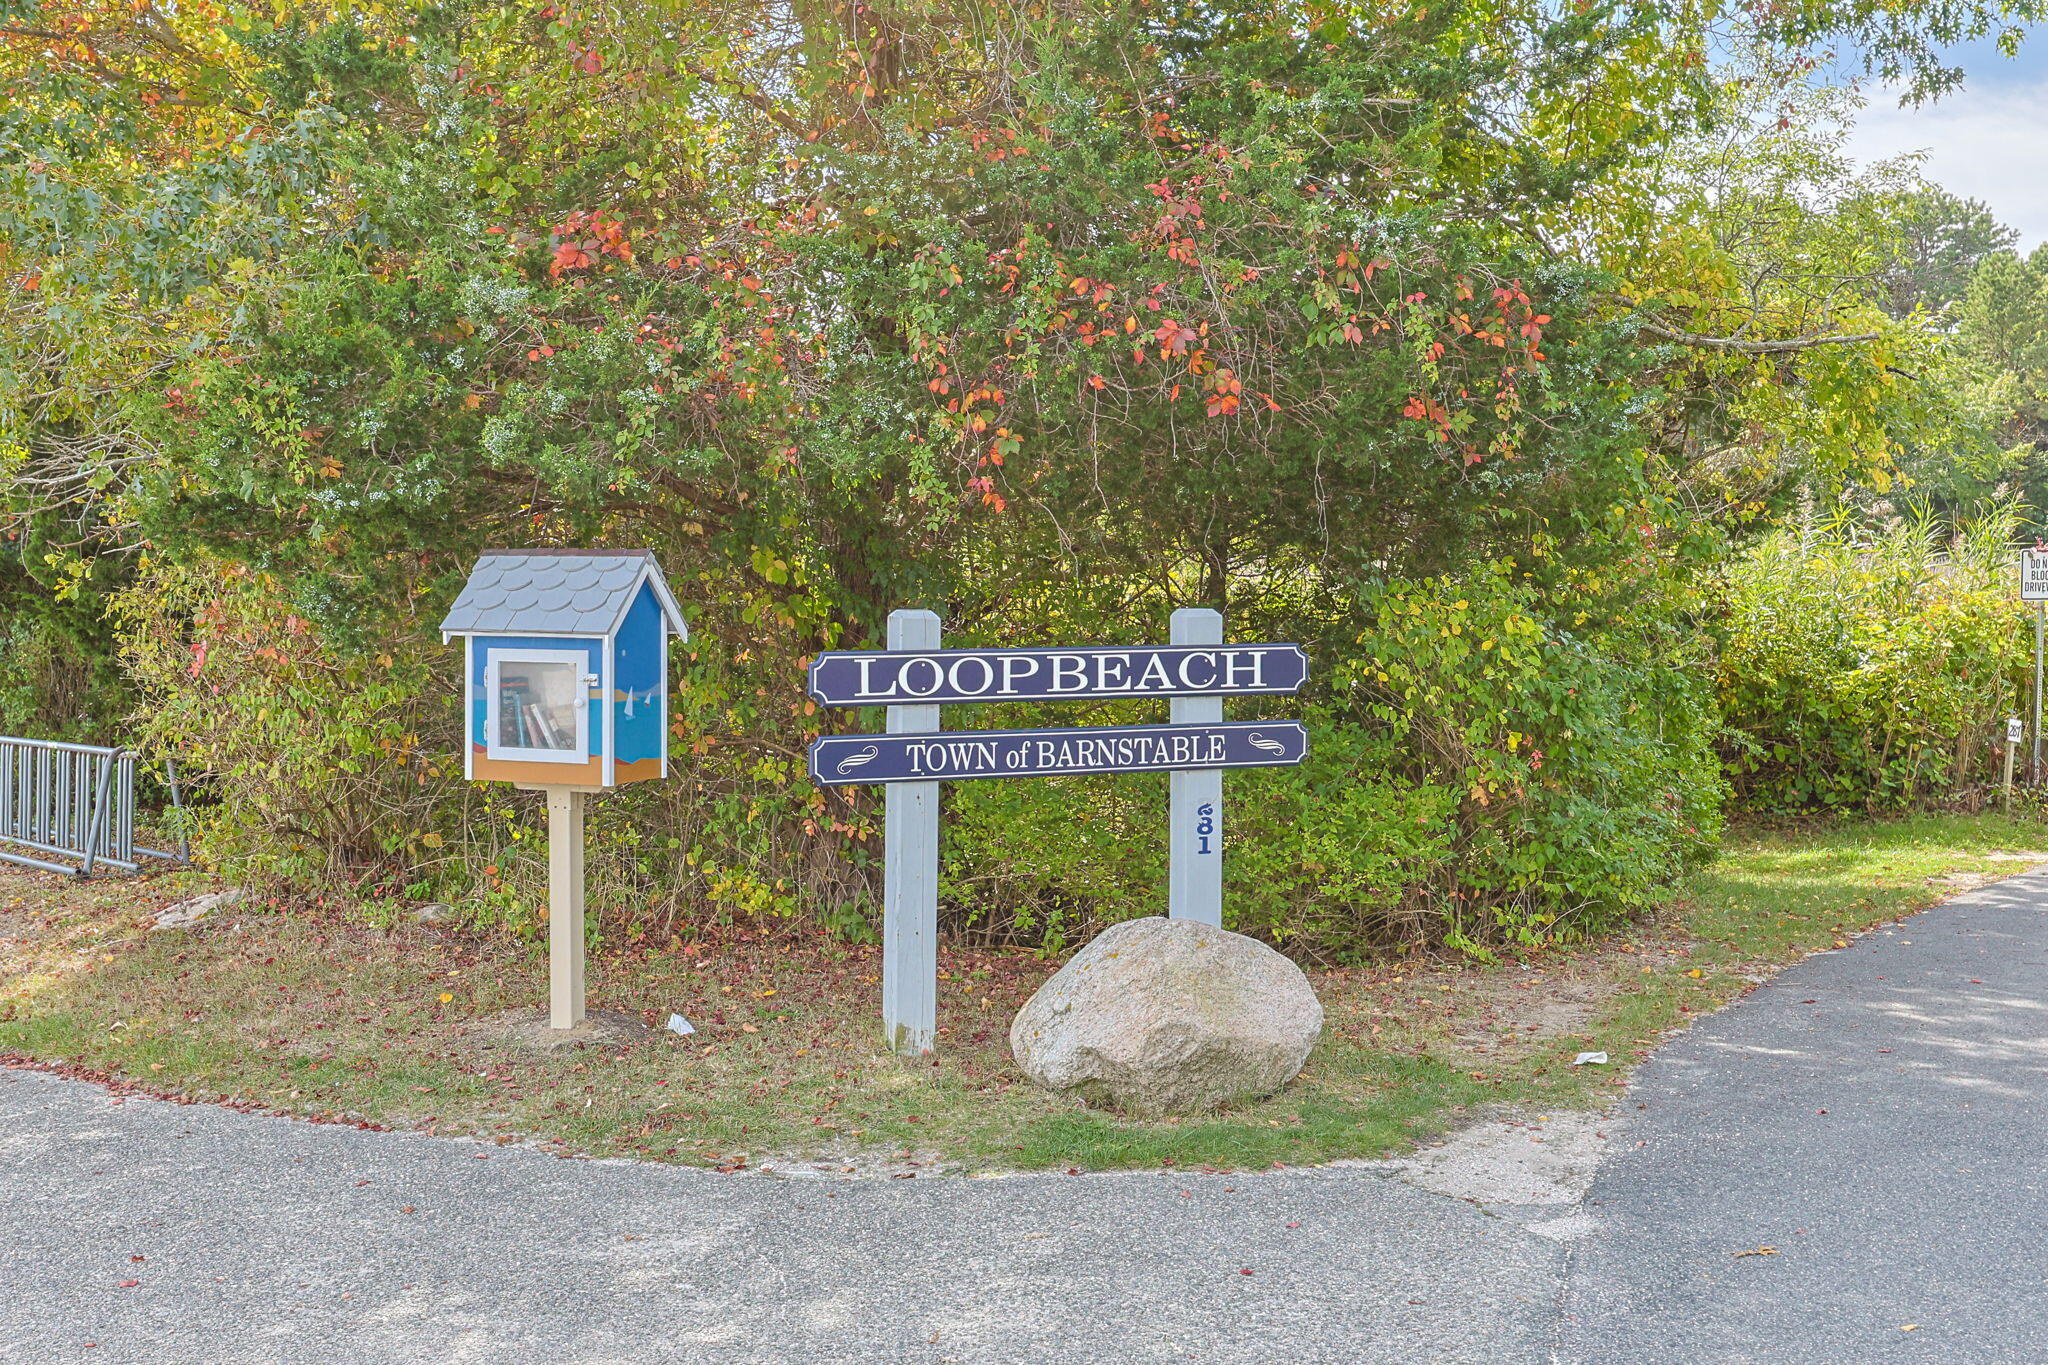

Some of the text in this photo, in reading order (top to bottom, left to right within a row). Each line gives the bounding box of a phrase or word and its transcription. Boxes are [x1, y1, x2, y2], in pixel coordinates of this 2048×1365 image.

[2030, 558, 2041, 569] DO
[2024, 581, 2048, 592] DRIVE
[905, 733, 1227, 773] TOWN of BARNSTABLE
